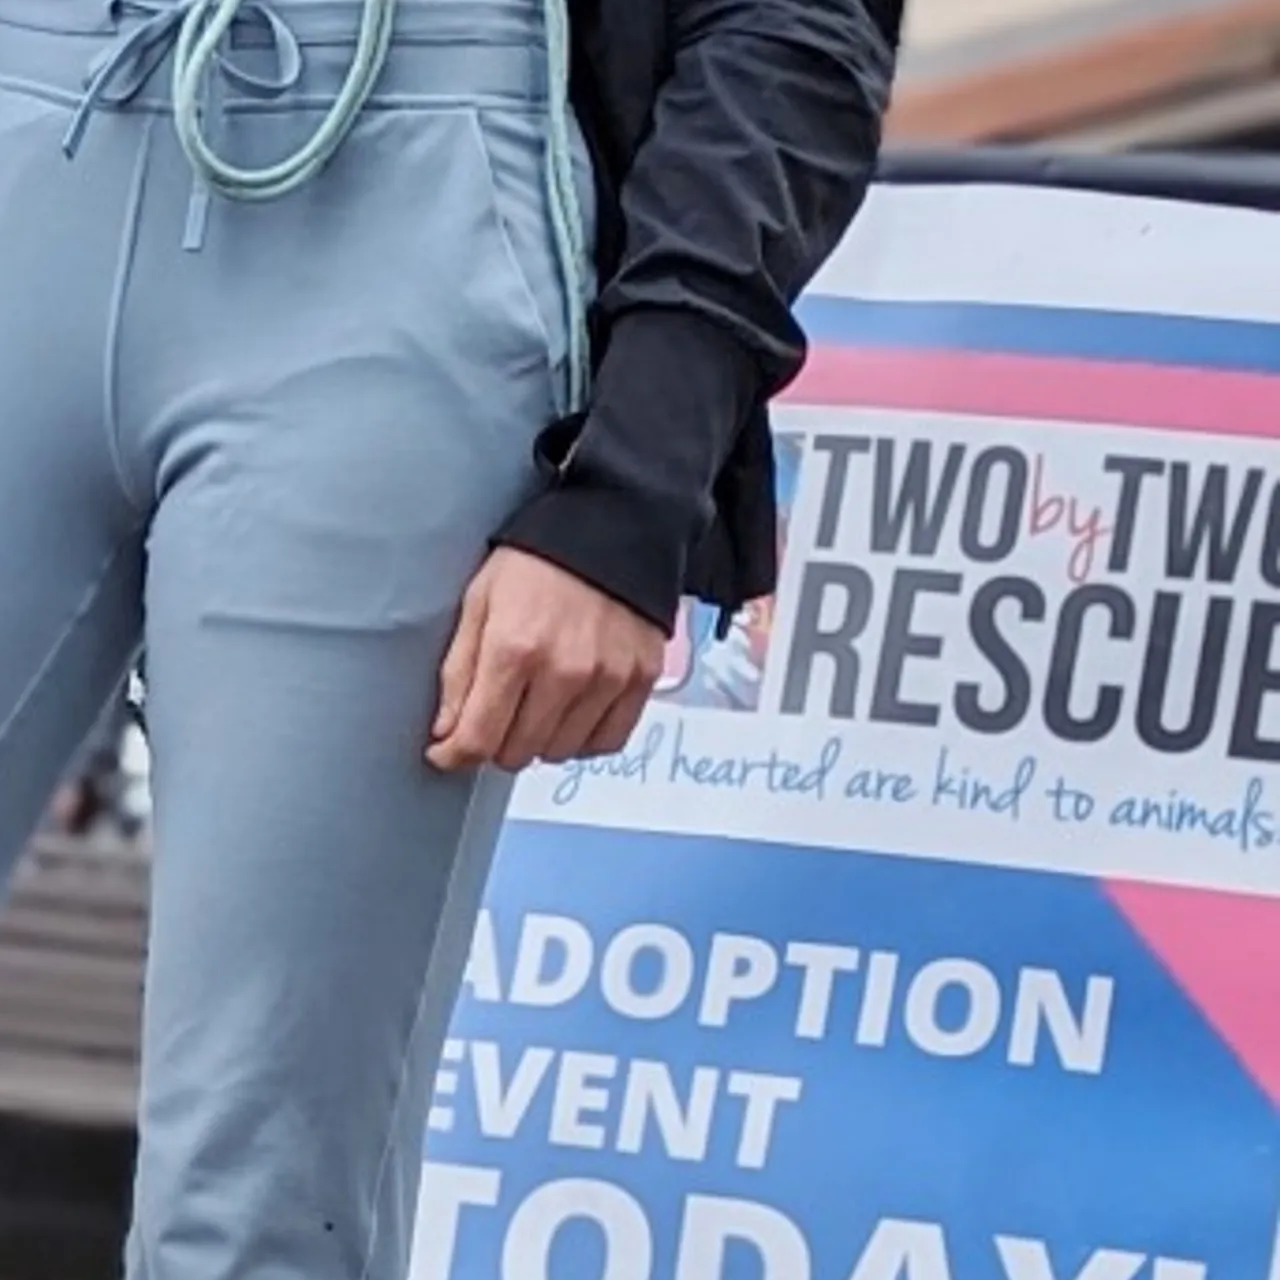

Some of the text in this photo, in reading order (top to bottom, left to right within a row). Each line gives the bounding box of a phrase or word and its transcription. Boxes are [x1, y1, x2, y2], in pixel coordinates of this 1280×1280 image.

[811, 434, 1029, 563] TWO
[1028, 453, 1112, 583] by
[669, 719, 842, 801] hearted
[843, 765, 918, 804] are
[931, 745, 1037, 819] kind
[1044, 776, 1096, 822] to
